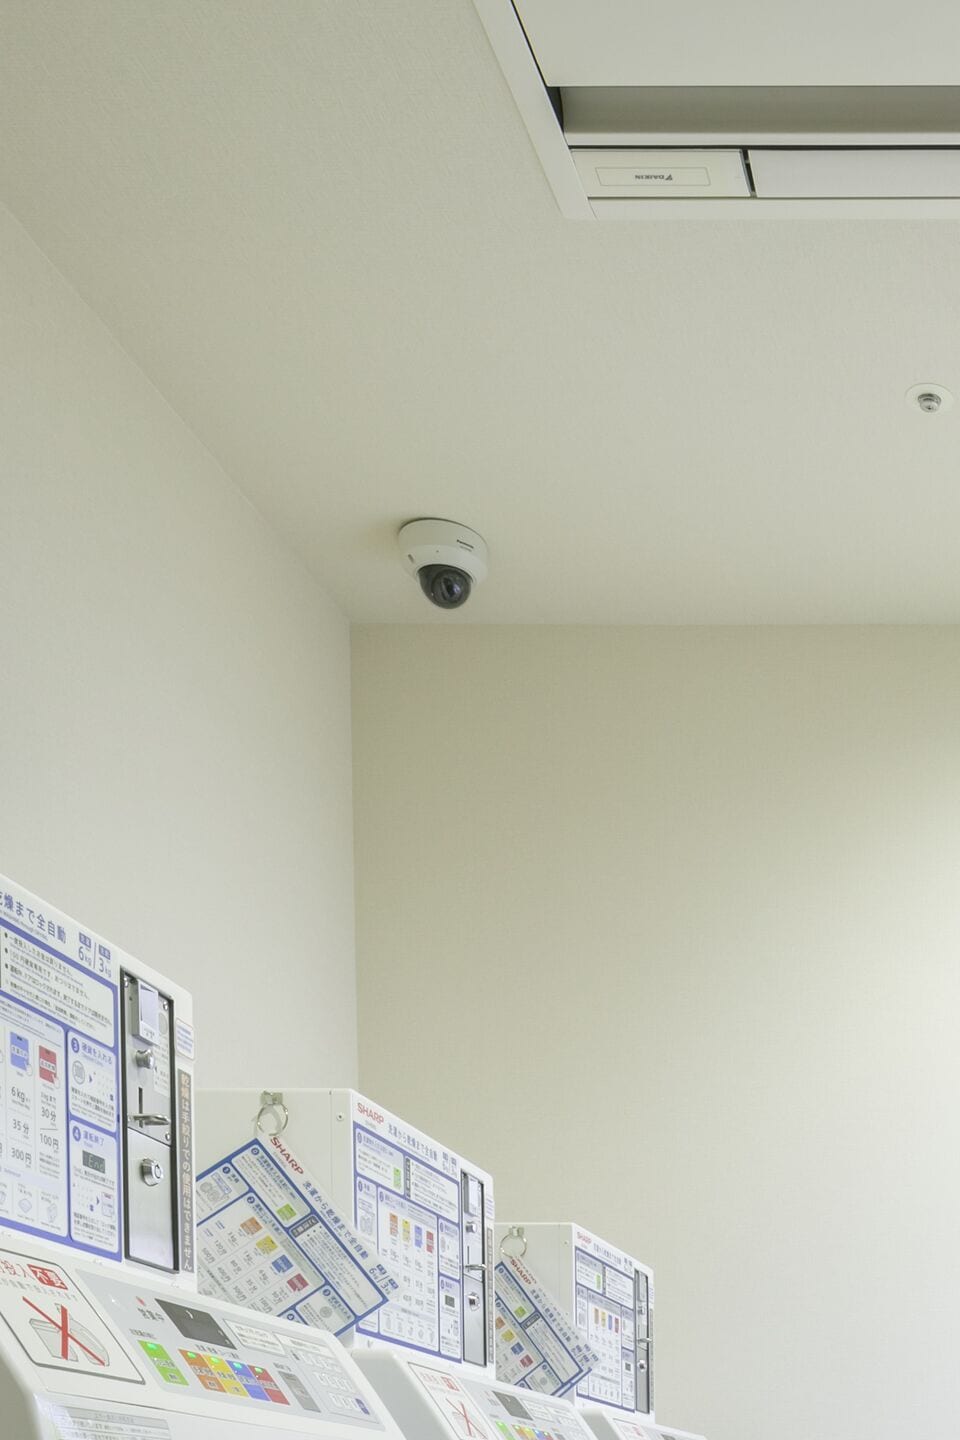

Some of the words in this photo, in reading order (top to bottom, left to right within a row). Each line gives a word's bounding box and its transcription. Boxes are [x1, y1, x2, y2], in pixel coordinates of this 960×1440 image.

[357, 1102, 384, 1125] SHARP
[270, 1136, 304, 1175] SHARP
[510, 1258, 532, 1285] SHARP
